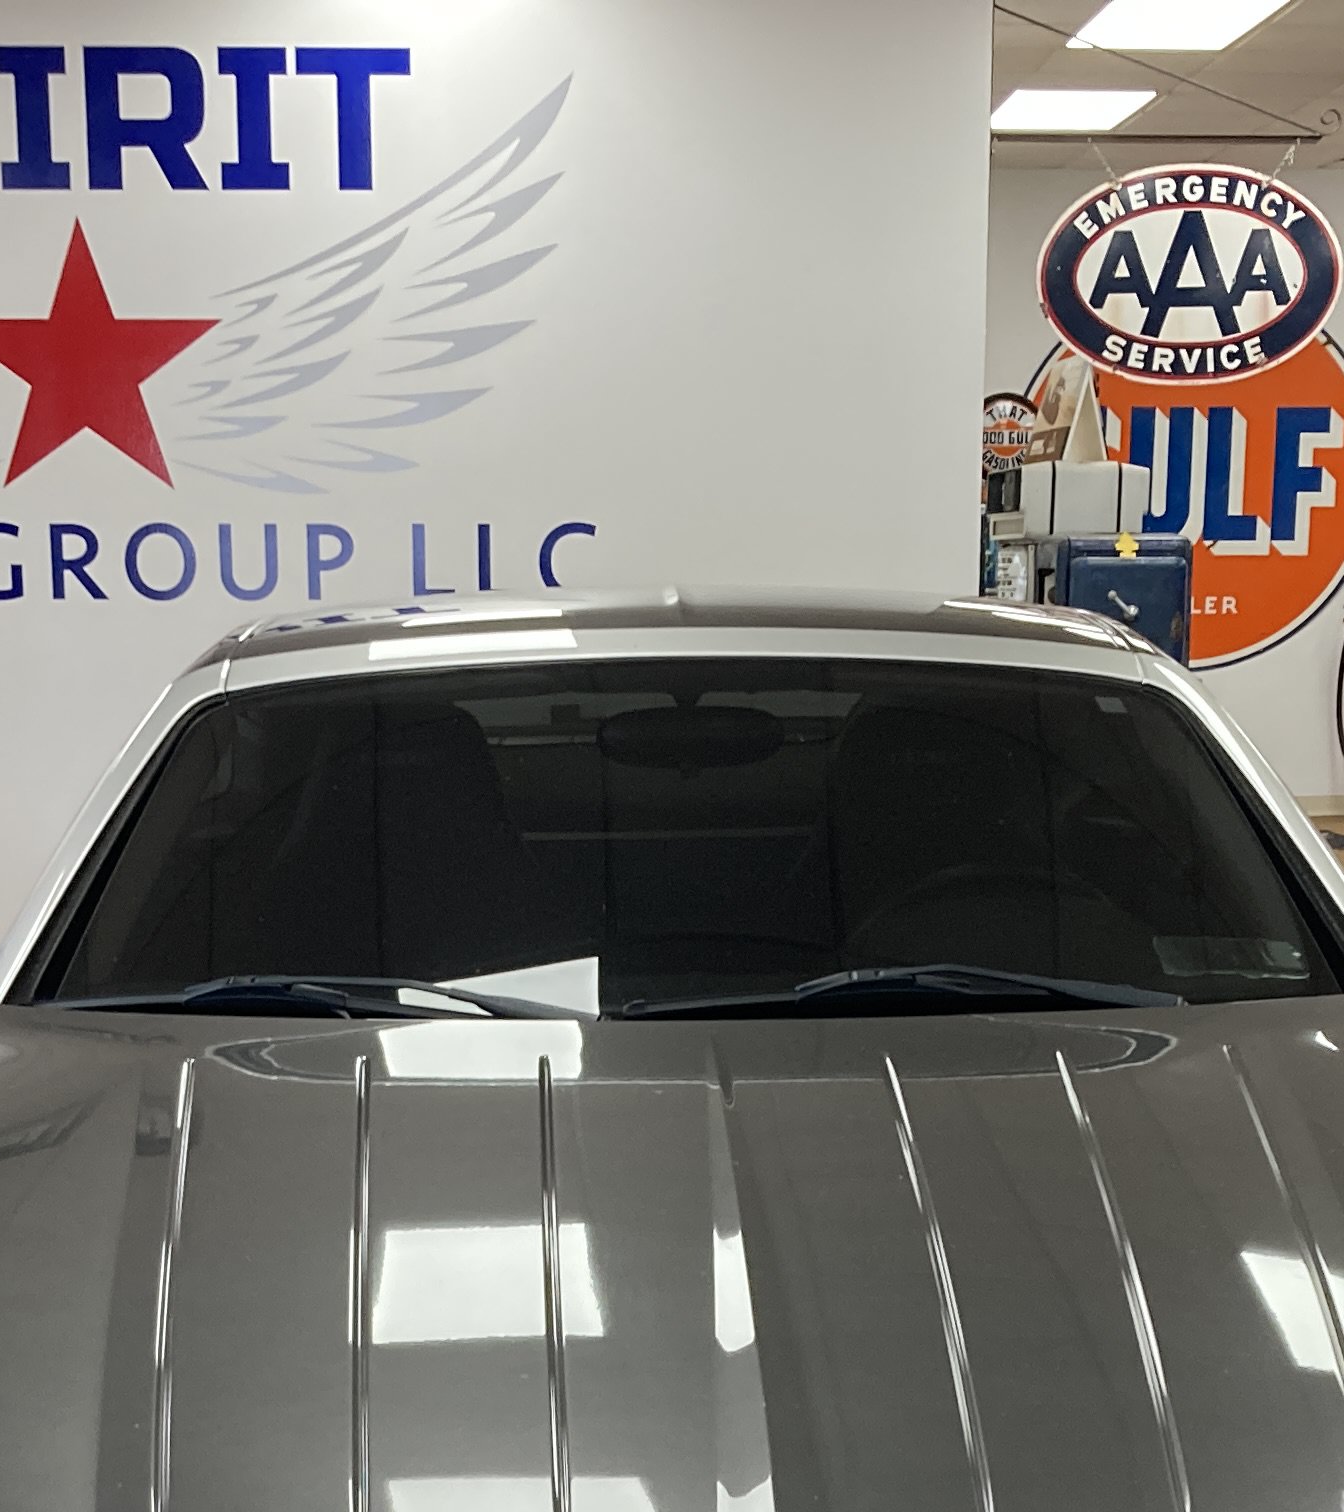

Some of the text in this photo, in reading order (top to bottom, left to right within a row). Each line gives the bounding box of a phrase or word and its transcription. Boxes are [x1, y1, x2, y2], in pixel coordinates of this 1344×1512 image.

[1072, 175, 1307, 240] EMERGENCY
[1089, 209, 1292, 338] AAA
[1102, 334, 1267, 374] SERVICE
[985, 405, 1028, 422] THAT
[982, 431, 1029, 445] OOD GUL
